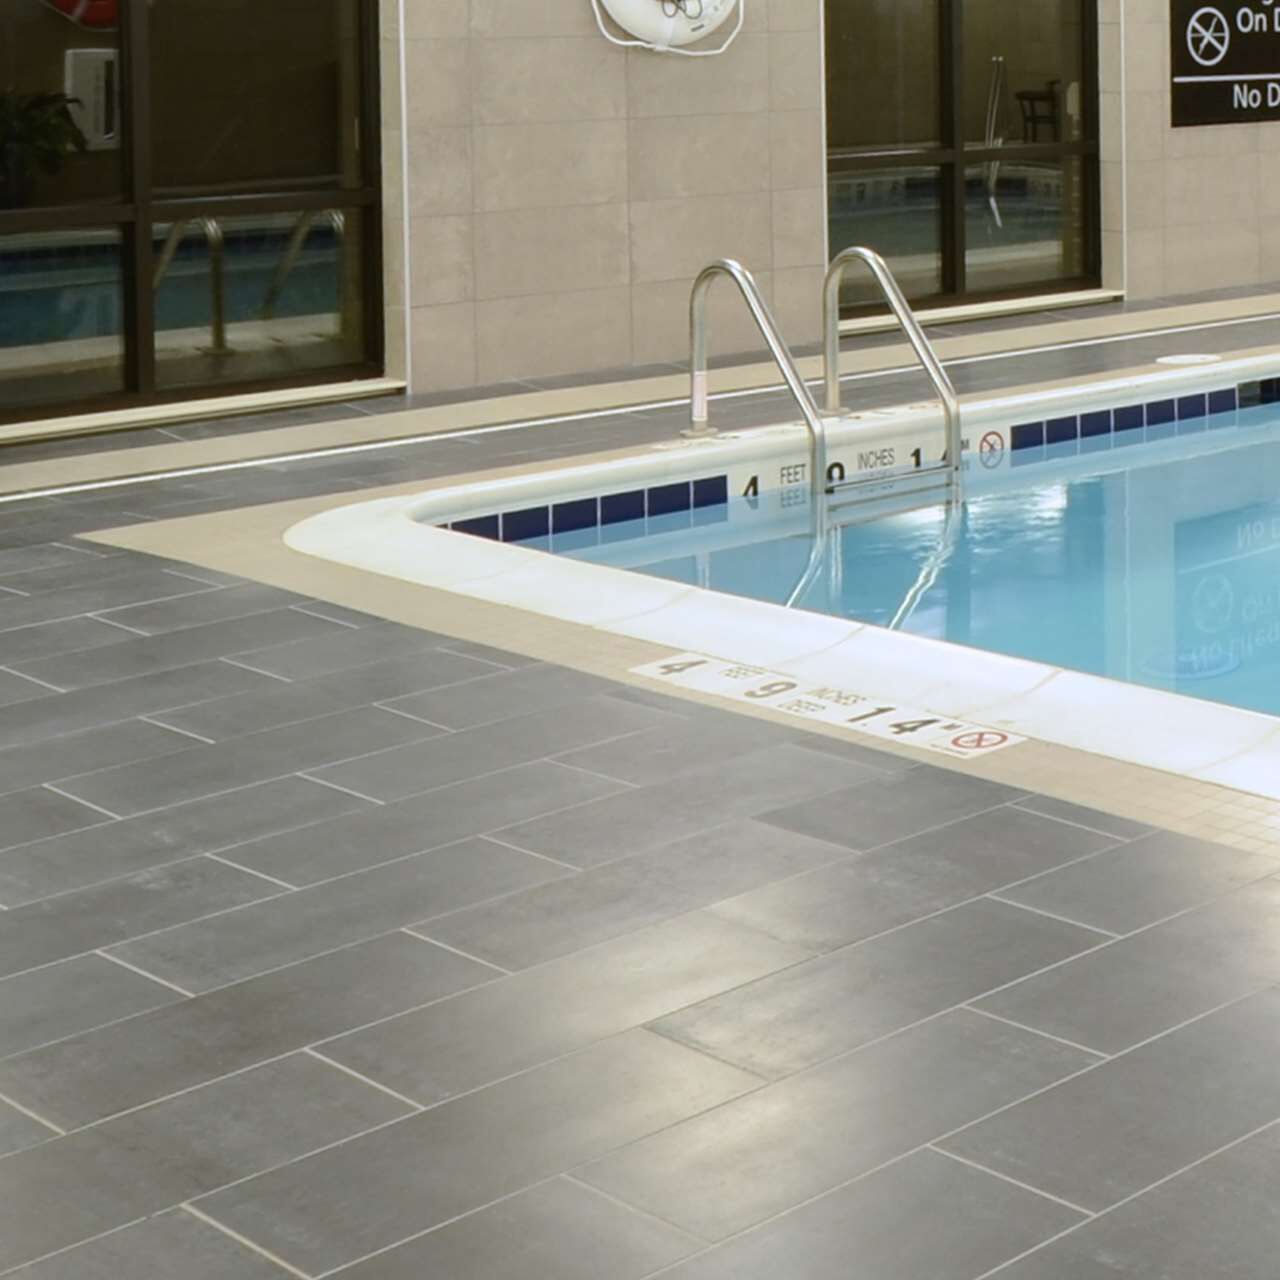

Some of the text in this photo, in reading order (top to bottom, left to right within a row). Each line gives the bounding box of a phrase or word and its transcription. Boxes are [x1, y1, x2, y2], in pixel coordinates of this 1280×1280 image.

[1236, 7, 1267, 33] On
[1233, 83, 1261, 109] No
[780, 463, 807, 485] FEET
[858, 447, 895, 471] INCHES
[659, 659, 708, 676] 4
[744, 681, 798, 698] 9
